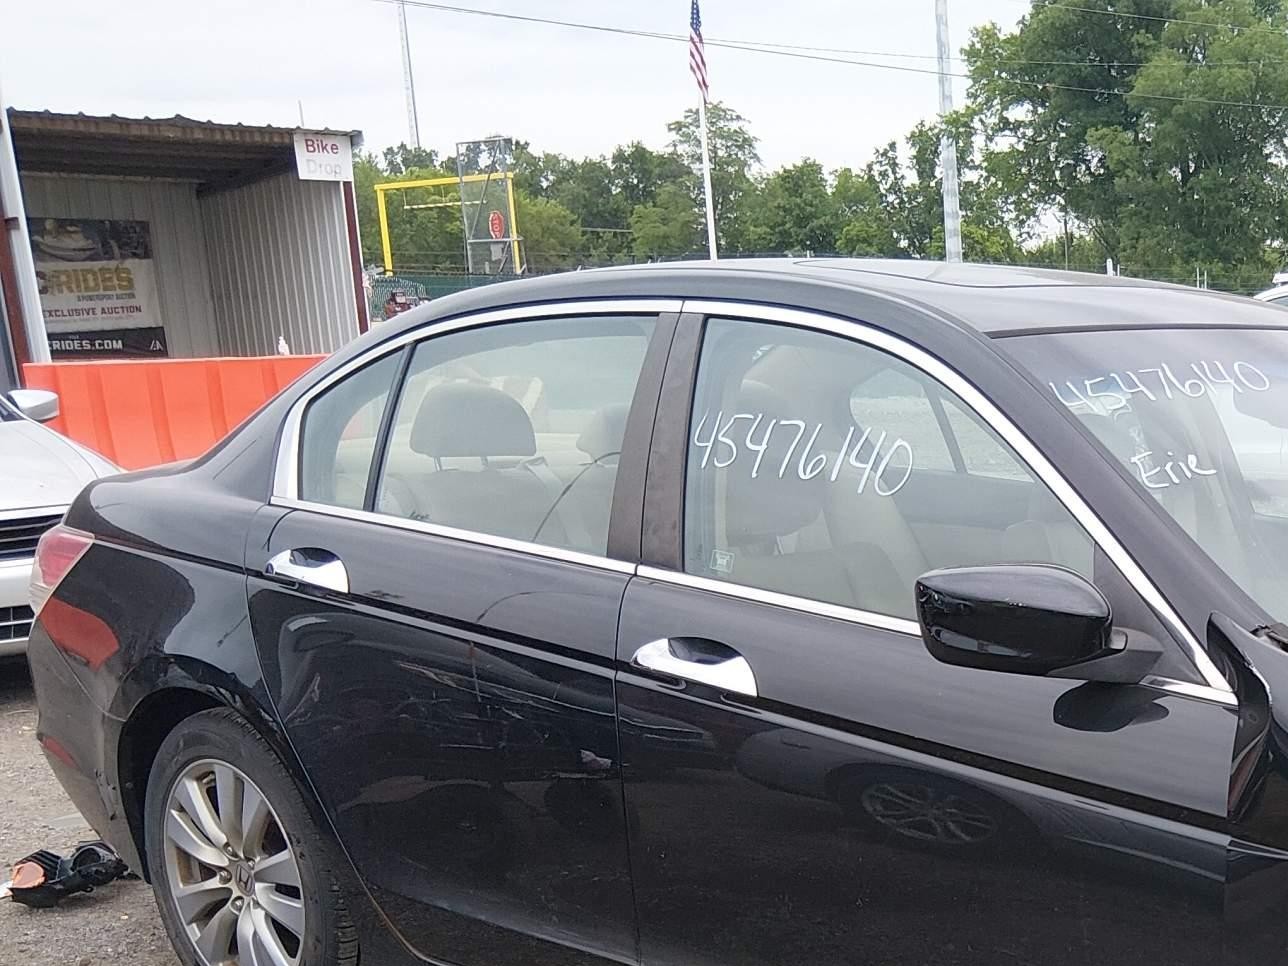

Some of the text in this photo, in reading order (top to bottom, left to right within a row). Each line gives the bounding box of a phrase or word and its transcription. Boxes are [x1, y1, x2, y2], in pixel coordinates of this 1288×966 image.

[304, 138, 339, 154] Bike
[306, 159, 342, 178] Drop
[100, 305, 142, 315] AUCTION
[1049, 360, 1270, 413] 45476140
[693, 407, 913, 497] 45476140
